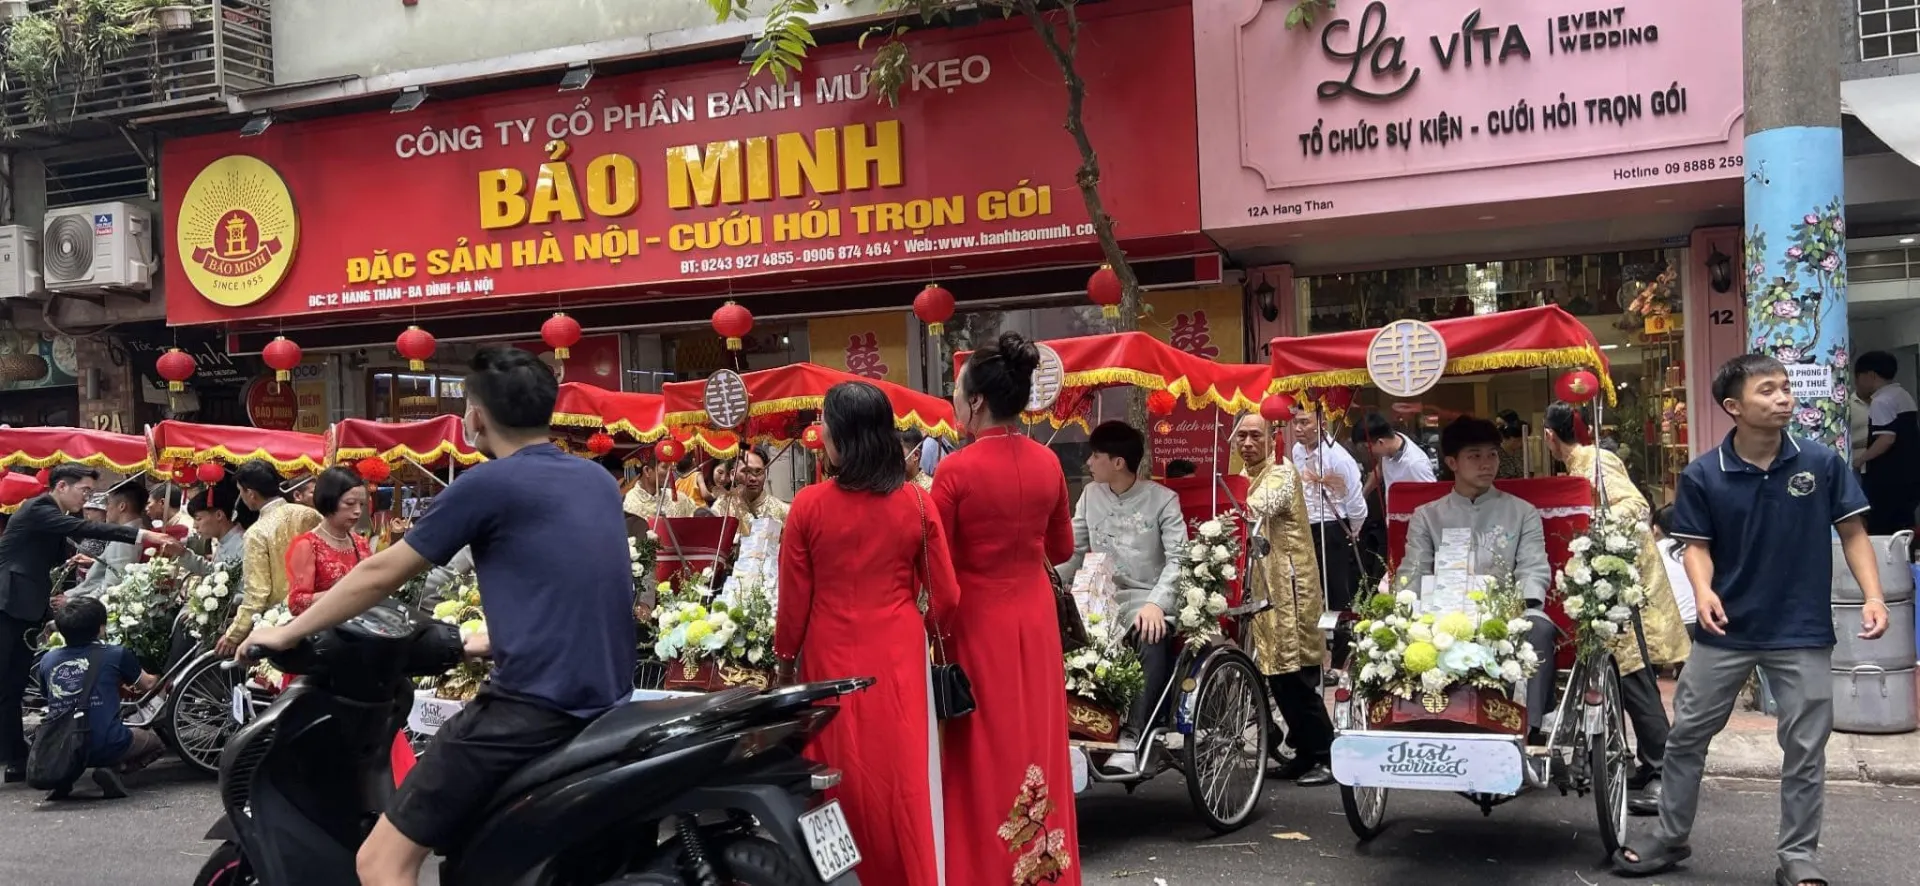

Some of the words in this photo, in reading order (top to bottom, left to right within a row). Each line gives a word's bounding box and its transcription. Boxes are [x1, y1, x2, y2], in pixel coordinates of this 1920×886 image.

[1558, 7, 1625, 32] EVENT
[1317, 1, 1420, 99] La
[1559, 25, 1658, 54] WEDDING
[395, 125, 483, 159] CÔNG
[494, 117, 536, 146] TY
[546, 96, 594, 139] CỔ
[603, 88, 695, 132] PHẦN
[707, 77, 801, 119] BÁNH
[816, 64, 872, 104] MỨ
[911, 54, 991, 94] KẸO
[1299, 118, 1323, 156] TỔ
[1329, 119, 1379, 152] CHỨC
[1386, 118, 1413, 150] SỰ
[1420, 111, 1463, 146] KIỆN
[1487, 99, 1535, 135] CƯỚI
[1543, 93, 1577, 130] HỎI
[1584, 94, 1642, 126] TRỌN
[1651, 81, 1687, 116] GÓI
[478, 139, 640, 230] BẢO
[666, 119, 904, 209] MINH
[1613, 166, 1659, 181] Hotline
[1665, 162, 1680, 175] 09
[1683, 159, 1715, 172] 8888
[1719, 156, 1744, 169] 259
[1247, 206, 1269, 217] 12A
[1273, 203, 1302, 215] Hang
[1304, 200, 1334, 211] Than
[346, 248, 417, 285] ĐẶC
[426, 237, 503, 275] SẢN
[511, 231, 564, 268] HÀ
[574, 224, 640, 263] NỘI
[668, 209, 763, 252] CƯỚI
[773, 200, 840, 242] HỎI
[850, 195, 964, 236] TRỌN
[977, 179, 1052, 222] GÓI
[701, 258, 733, 272] 0243
[736, 255, 760, 269] 927
[838, 244, 862, 259] 874
[904, 223, 1098, 253] Web:www.banhbaominh.co
[234, 252, 267, 274] MINH
[212, 279, 239, 291] SINCE
[242, 274, 264, 290] 1955
[1709, 309, 1735, 325] 12
[1791, 380, 1803, 388] HO
[92, 412, 122, 433] 12A
[1387, 741, 1457, 763] Just
[1379, 757, 1469, 777] married
[808, 806, 842, 844] 29-F1
